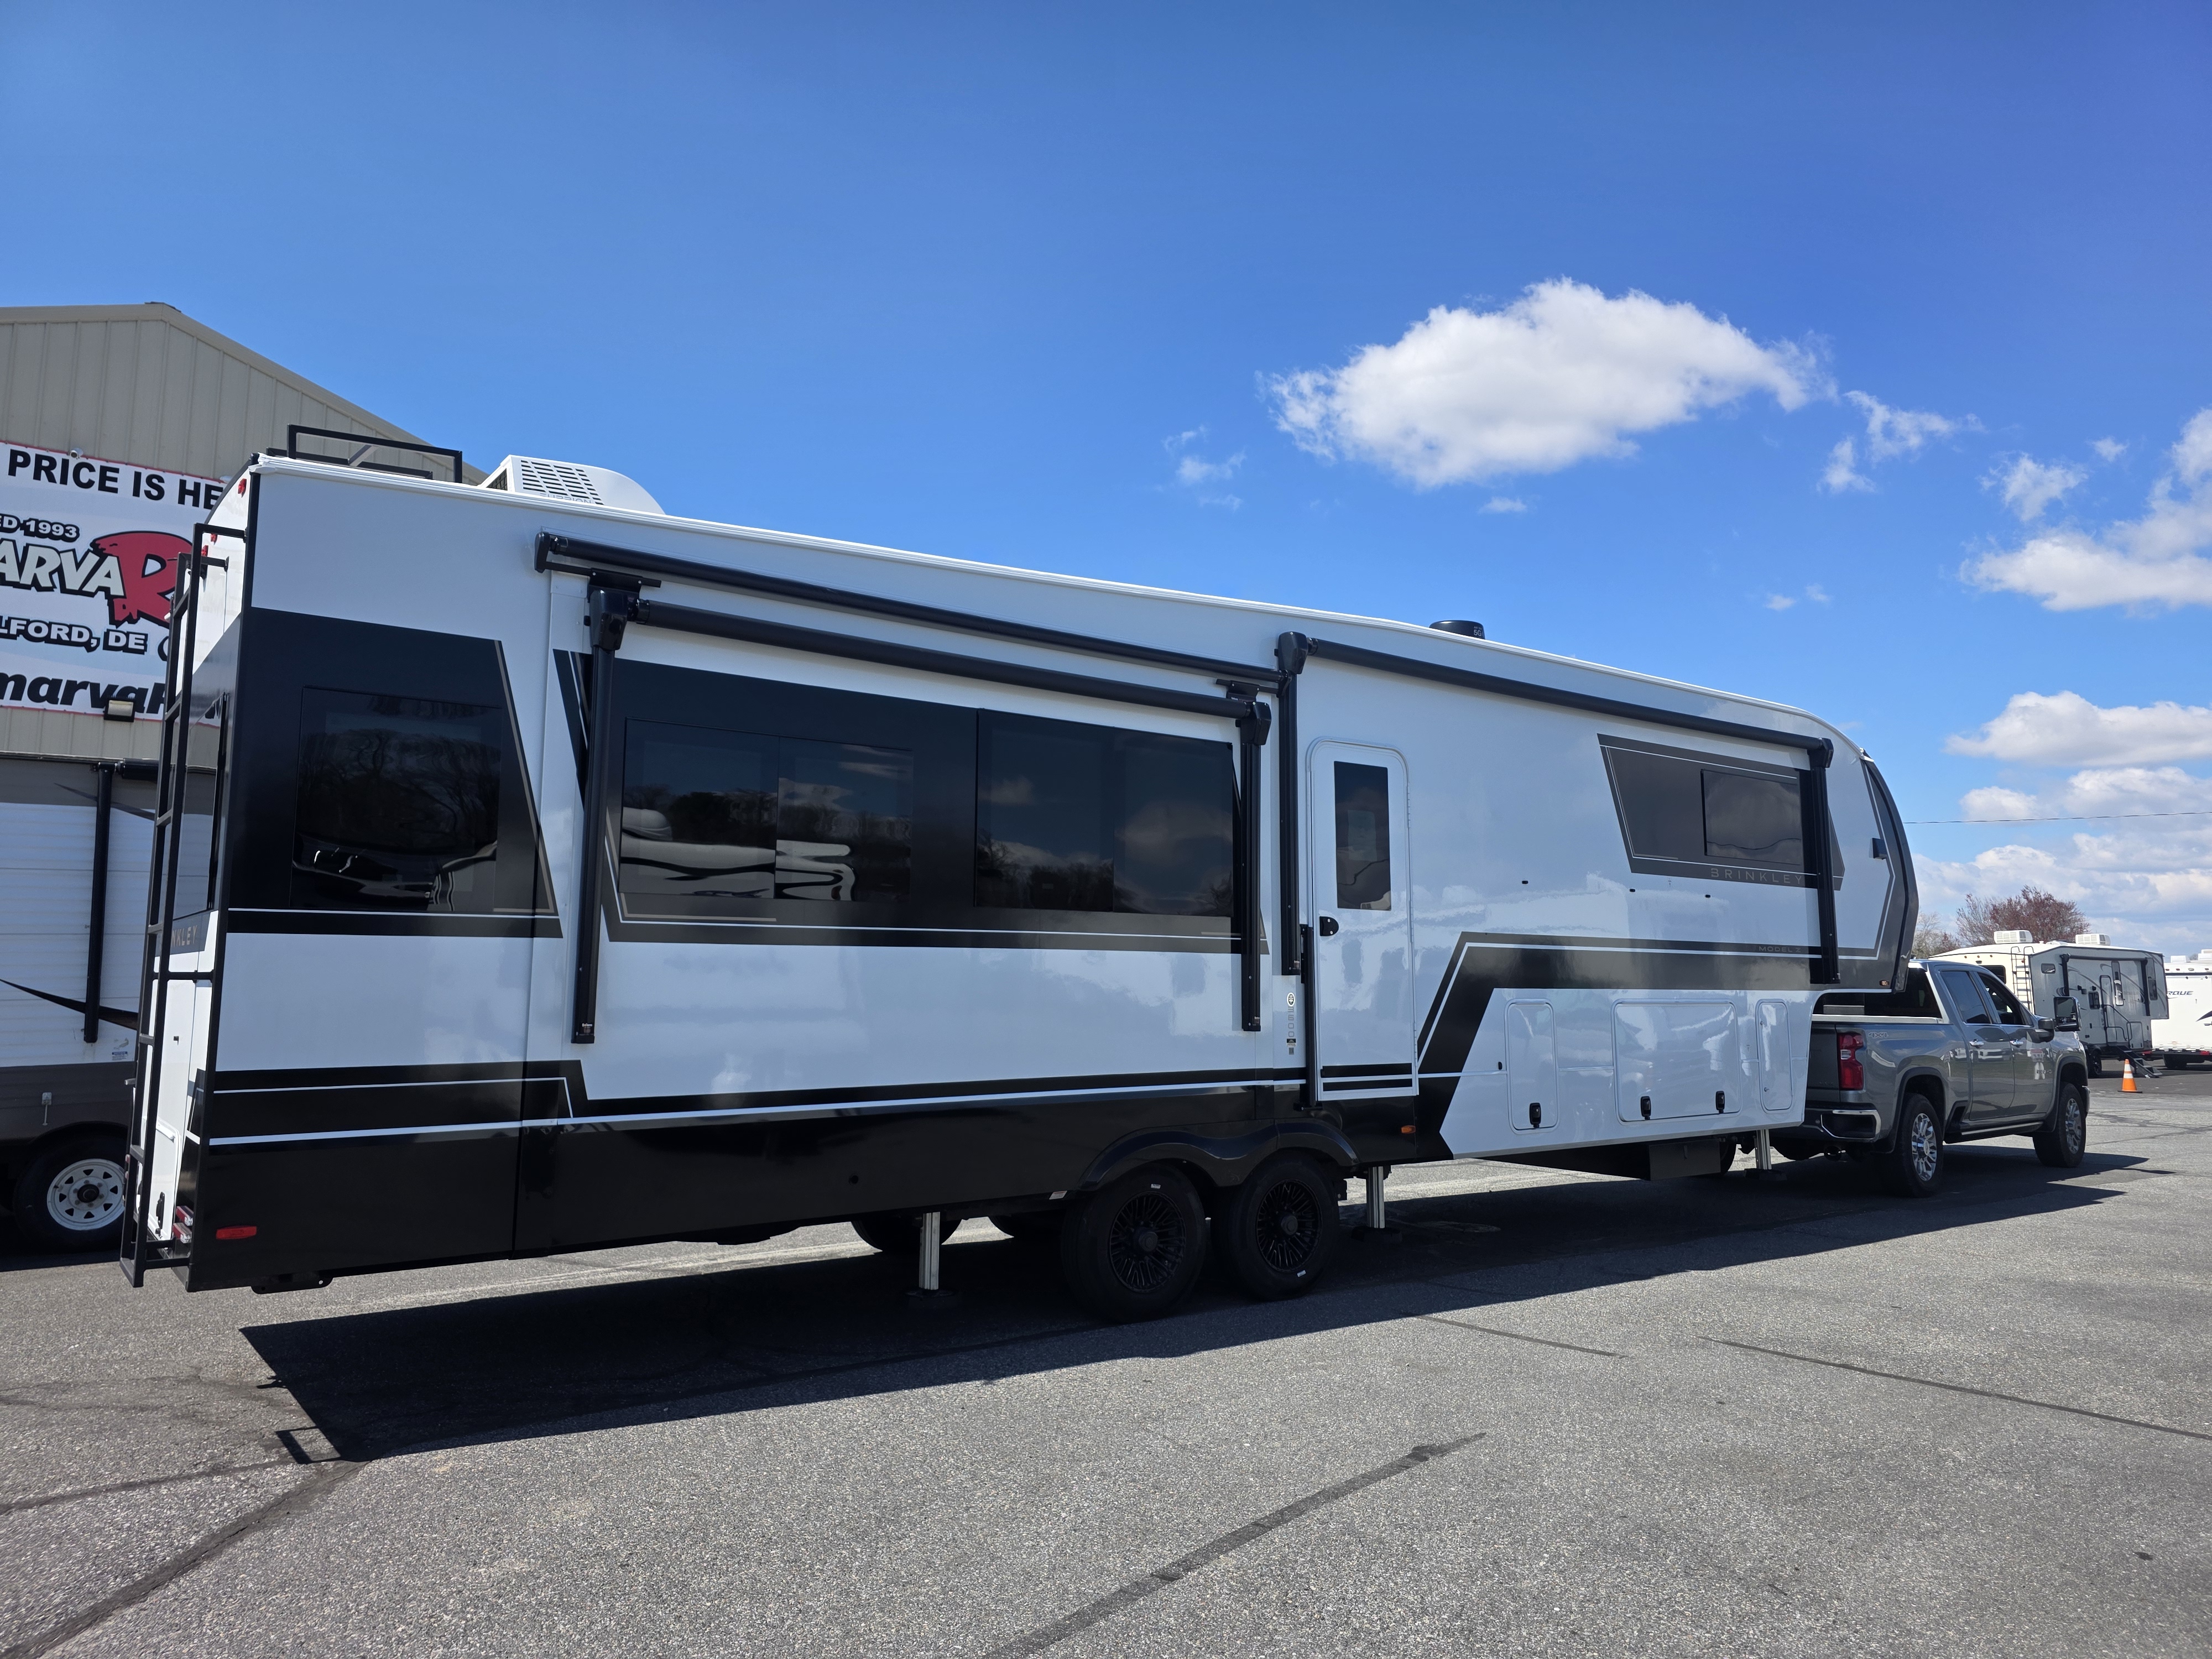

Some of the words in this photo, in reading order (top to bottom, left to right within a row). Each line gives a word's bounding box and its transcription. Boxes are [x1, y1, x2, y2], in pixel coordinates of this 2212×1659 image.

[8, 448, 120, 494] PRICE
[132, 471, 165, 501] IS
[25, 519, 78, 539] 1993
[108, 630, 145, 649] DE
[1710, 867, 1802, 885] BRINKLEY
